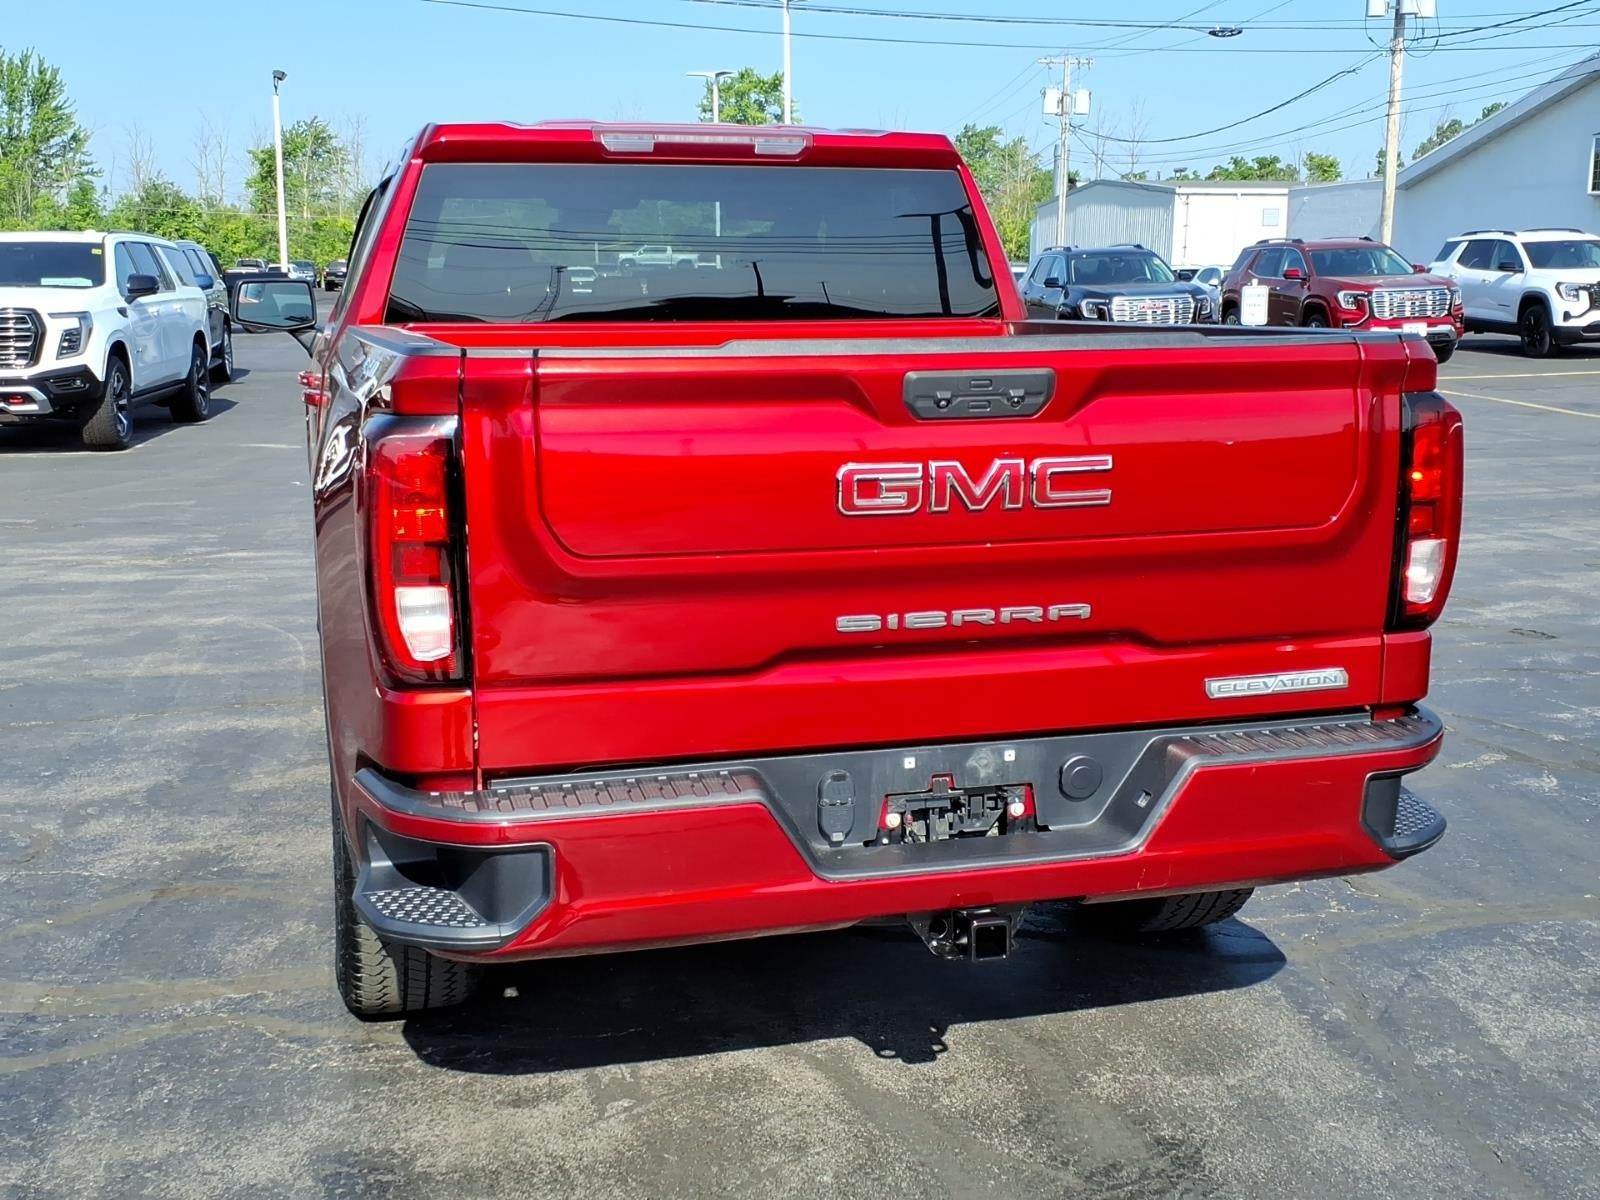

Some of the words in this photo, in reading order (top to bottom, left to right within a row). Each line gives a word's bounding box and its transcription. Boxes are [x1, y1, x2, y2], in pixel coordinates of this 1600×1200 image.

[836, 455, 1113, 516] GMC
[836, 603, 1091, 632] SIERRA
[1216, 674, 1339, 694] ELEVATION
